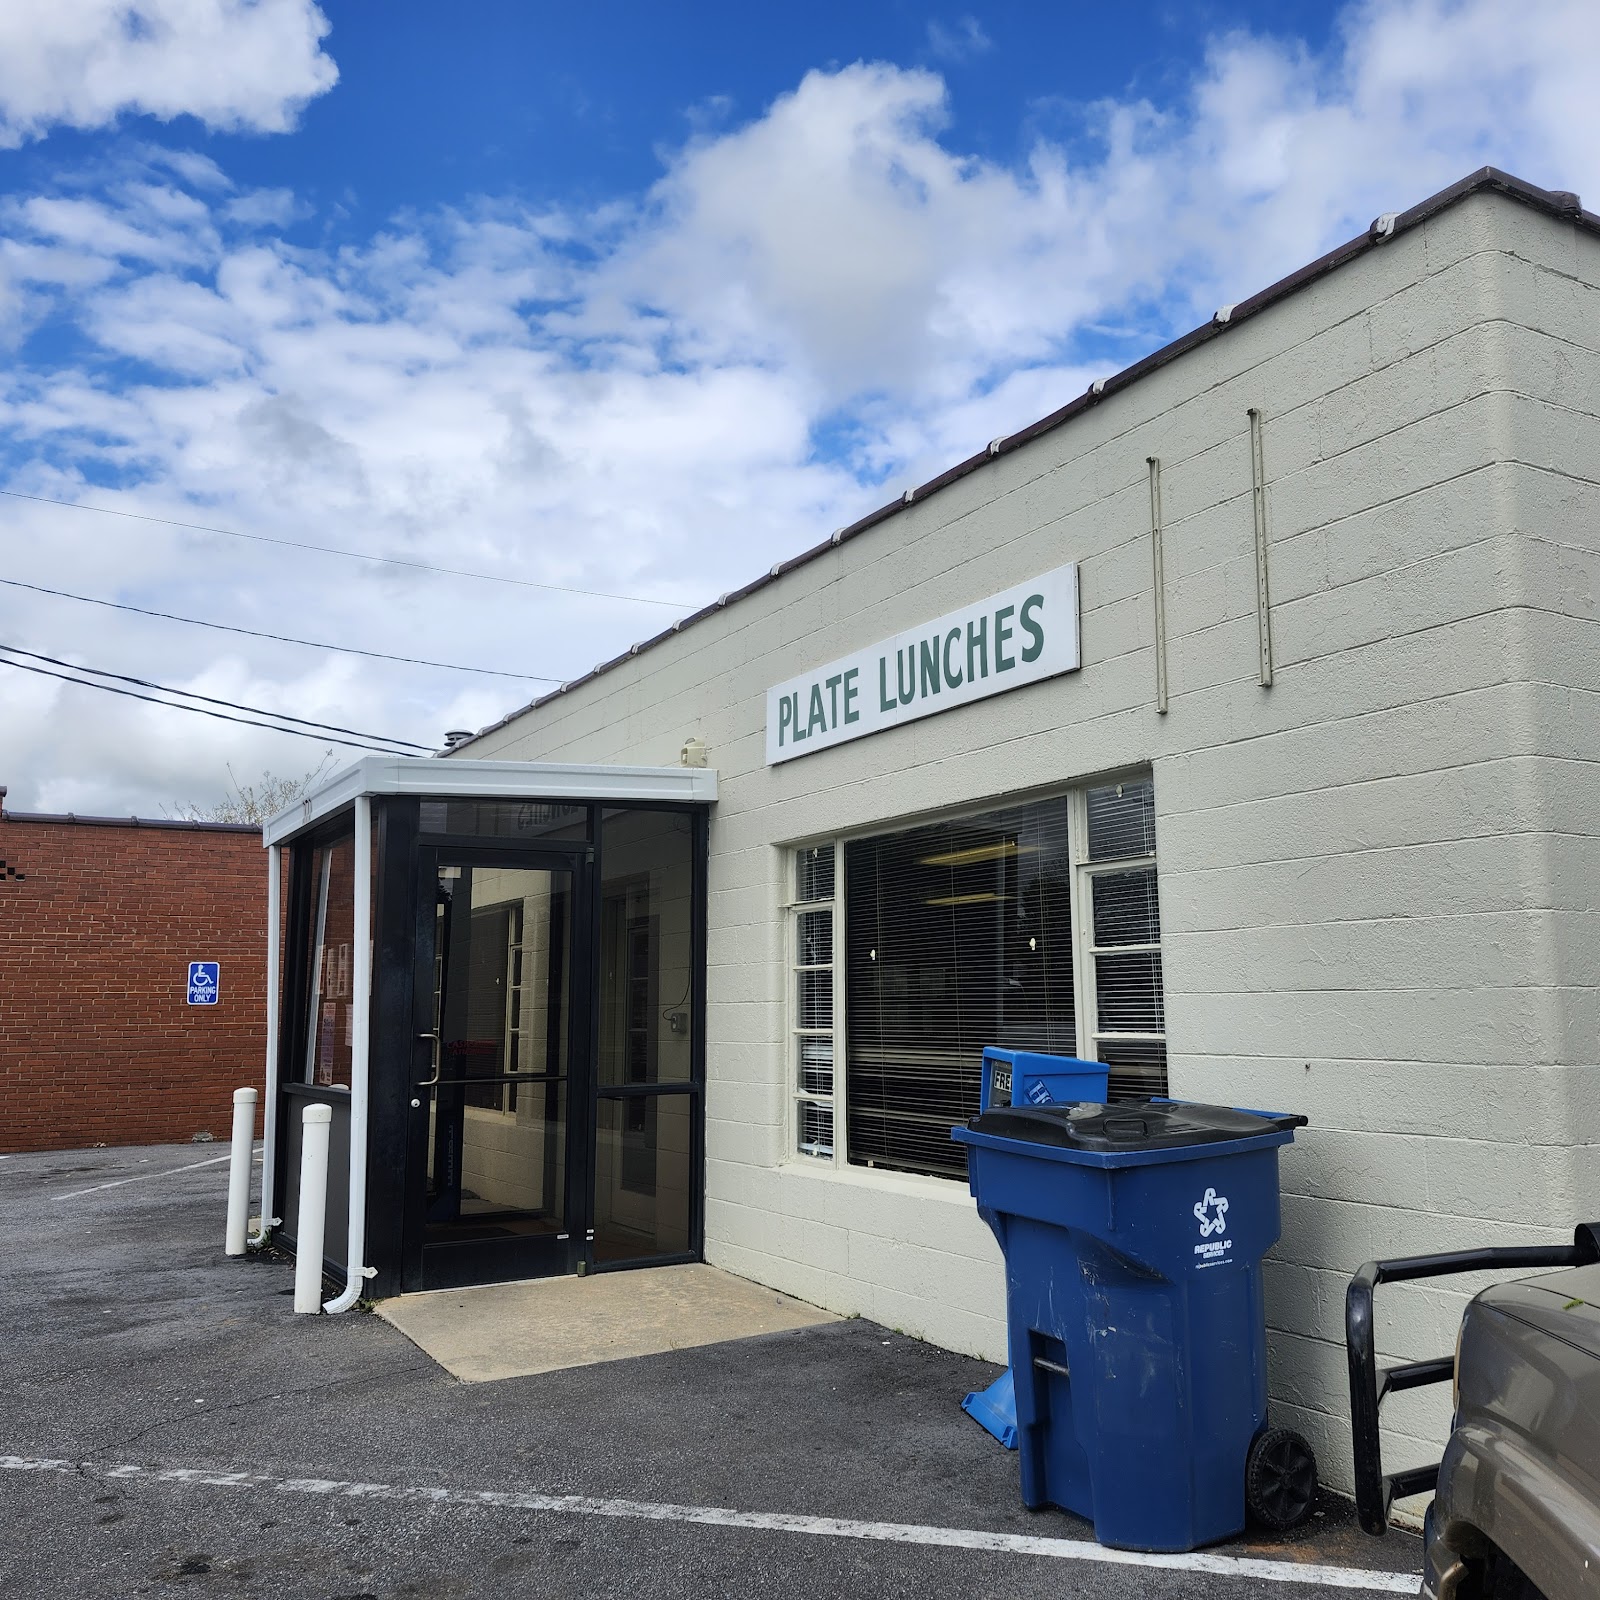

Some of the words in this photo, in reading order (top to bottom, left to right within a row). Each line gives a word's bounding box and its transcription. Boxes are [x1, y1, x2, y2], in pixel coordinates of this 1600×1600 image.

[779, 667, 860, 747] PLATE
[879, 593, 1045, 713] LUNCHES
[190, 986, 216, 995] PARKING
[194, 994, 211, 1002] ONLY
[994, 1071, 1013, 1091] FRE
[1194, 1239, 1232, 1254] REPUBLIC
